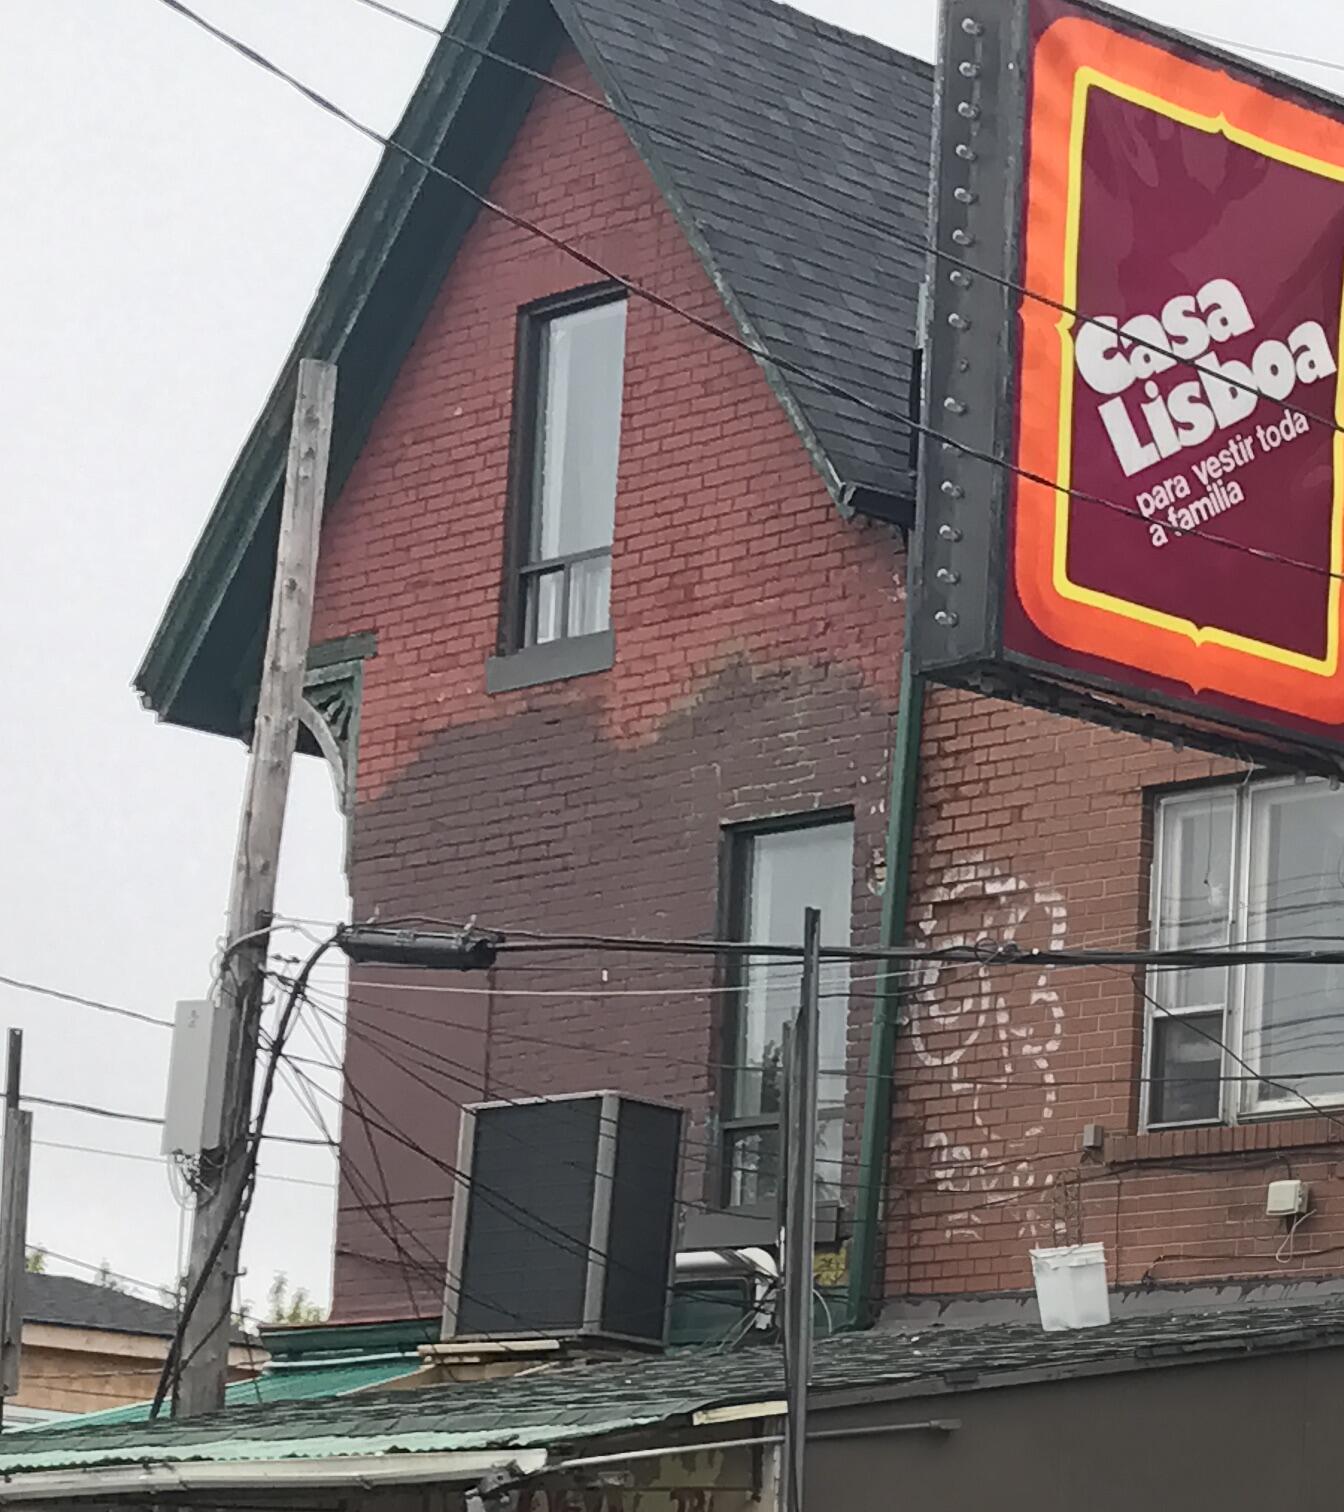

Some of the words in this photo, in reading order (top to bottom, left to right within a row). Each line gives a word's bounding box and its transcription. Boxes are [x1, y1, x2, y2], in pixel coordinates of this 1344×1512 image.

[1074, 279, 1255, 395] Casa
[1098, 320, 1337, 477] Lisboa
[1136, 470, 1191, 519] para
[1191, 432, 1255, 485] vestir
[1254, 407, 1310, 456] toda
[1149, 522, 1168, 548] a
[1167, 478, 1246, 538] familia
